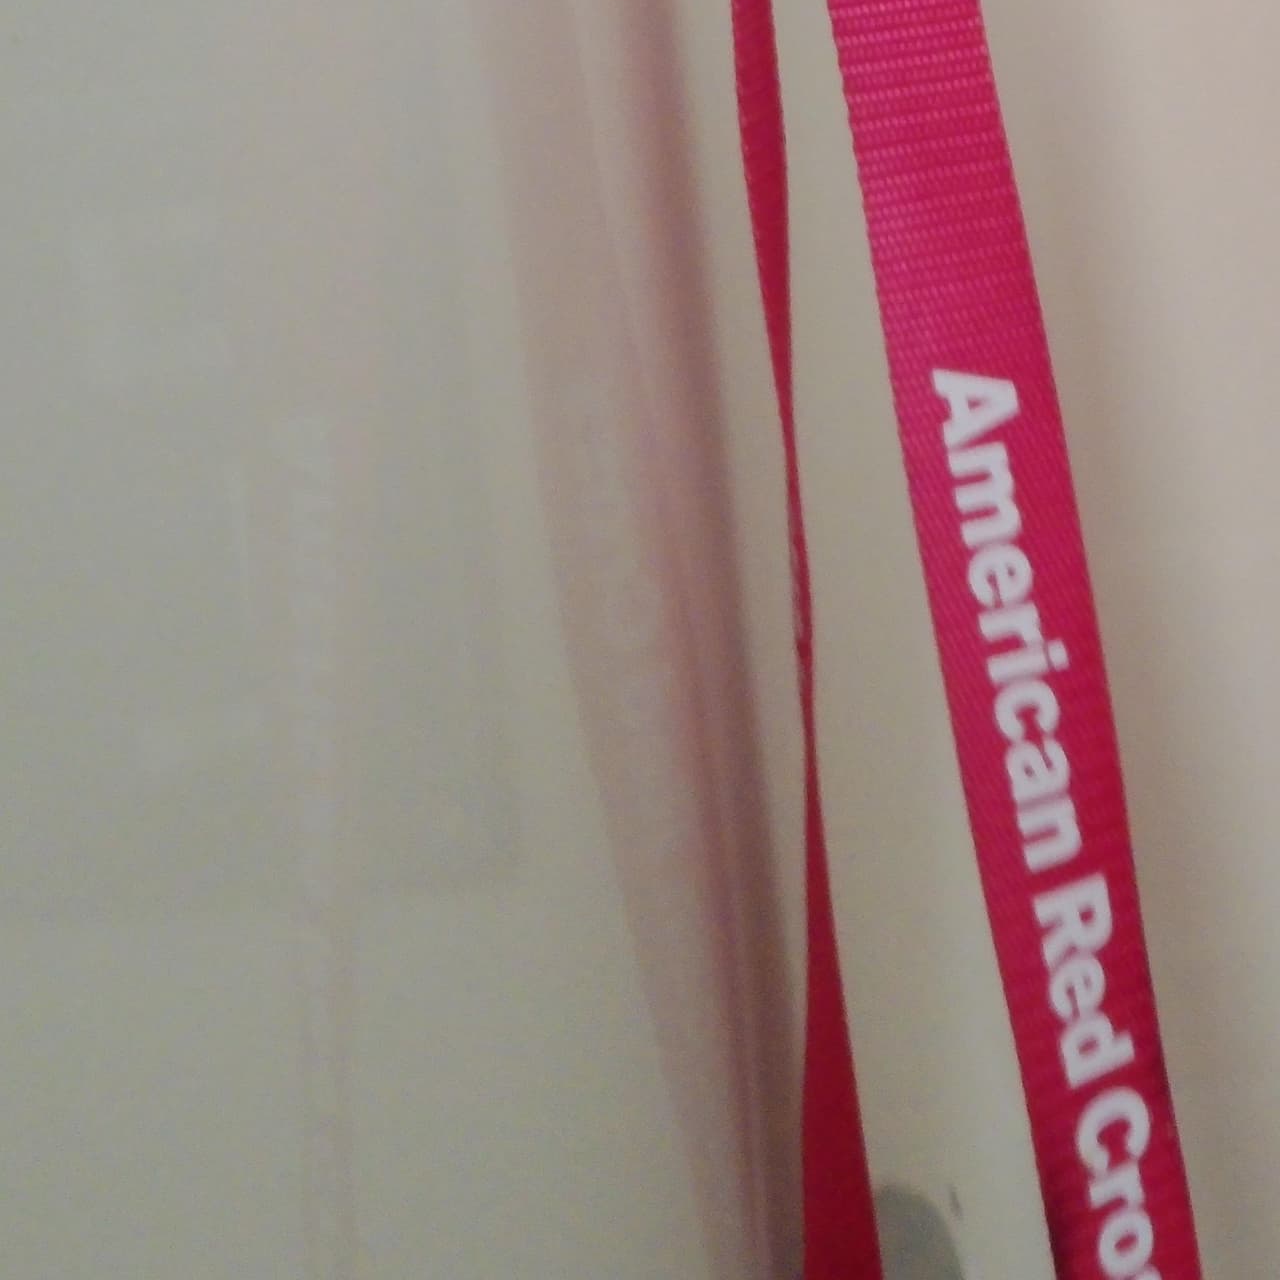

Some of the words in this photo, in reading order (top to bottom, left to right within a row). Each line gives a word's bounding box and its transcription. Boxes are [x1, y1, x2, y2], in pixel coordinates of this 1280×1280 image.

[932, 368, 1083, 875] American
[1032, 872, 1135, 1091] Red
[1075, 1085, 1165, 1280] Cro
